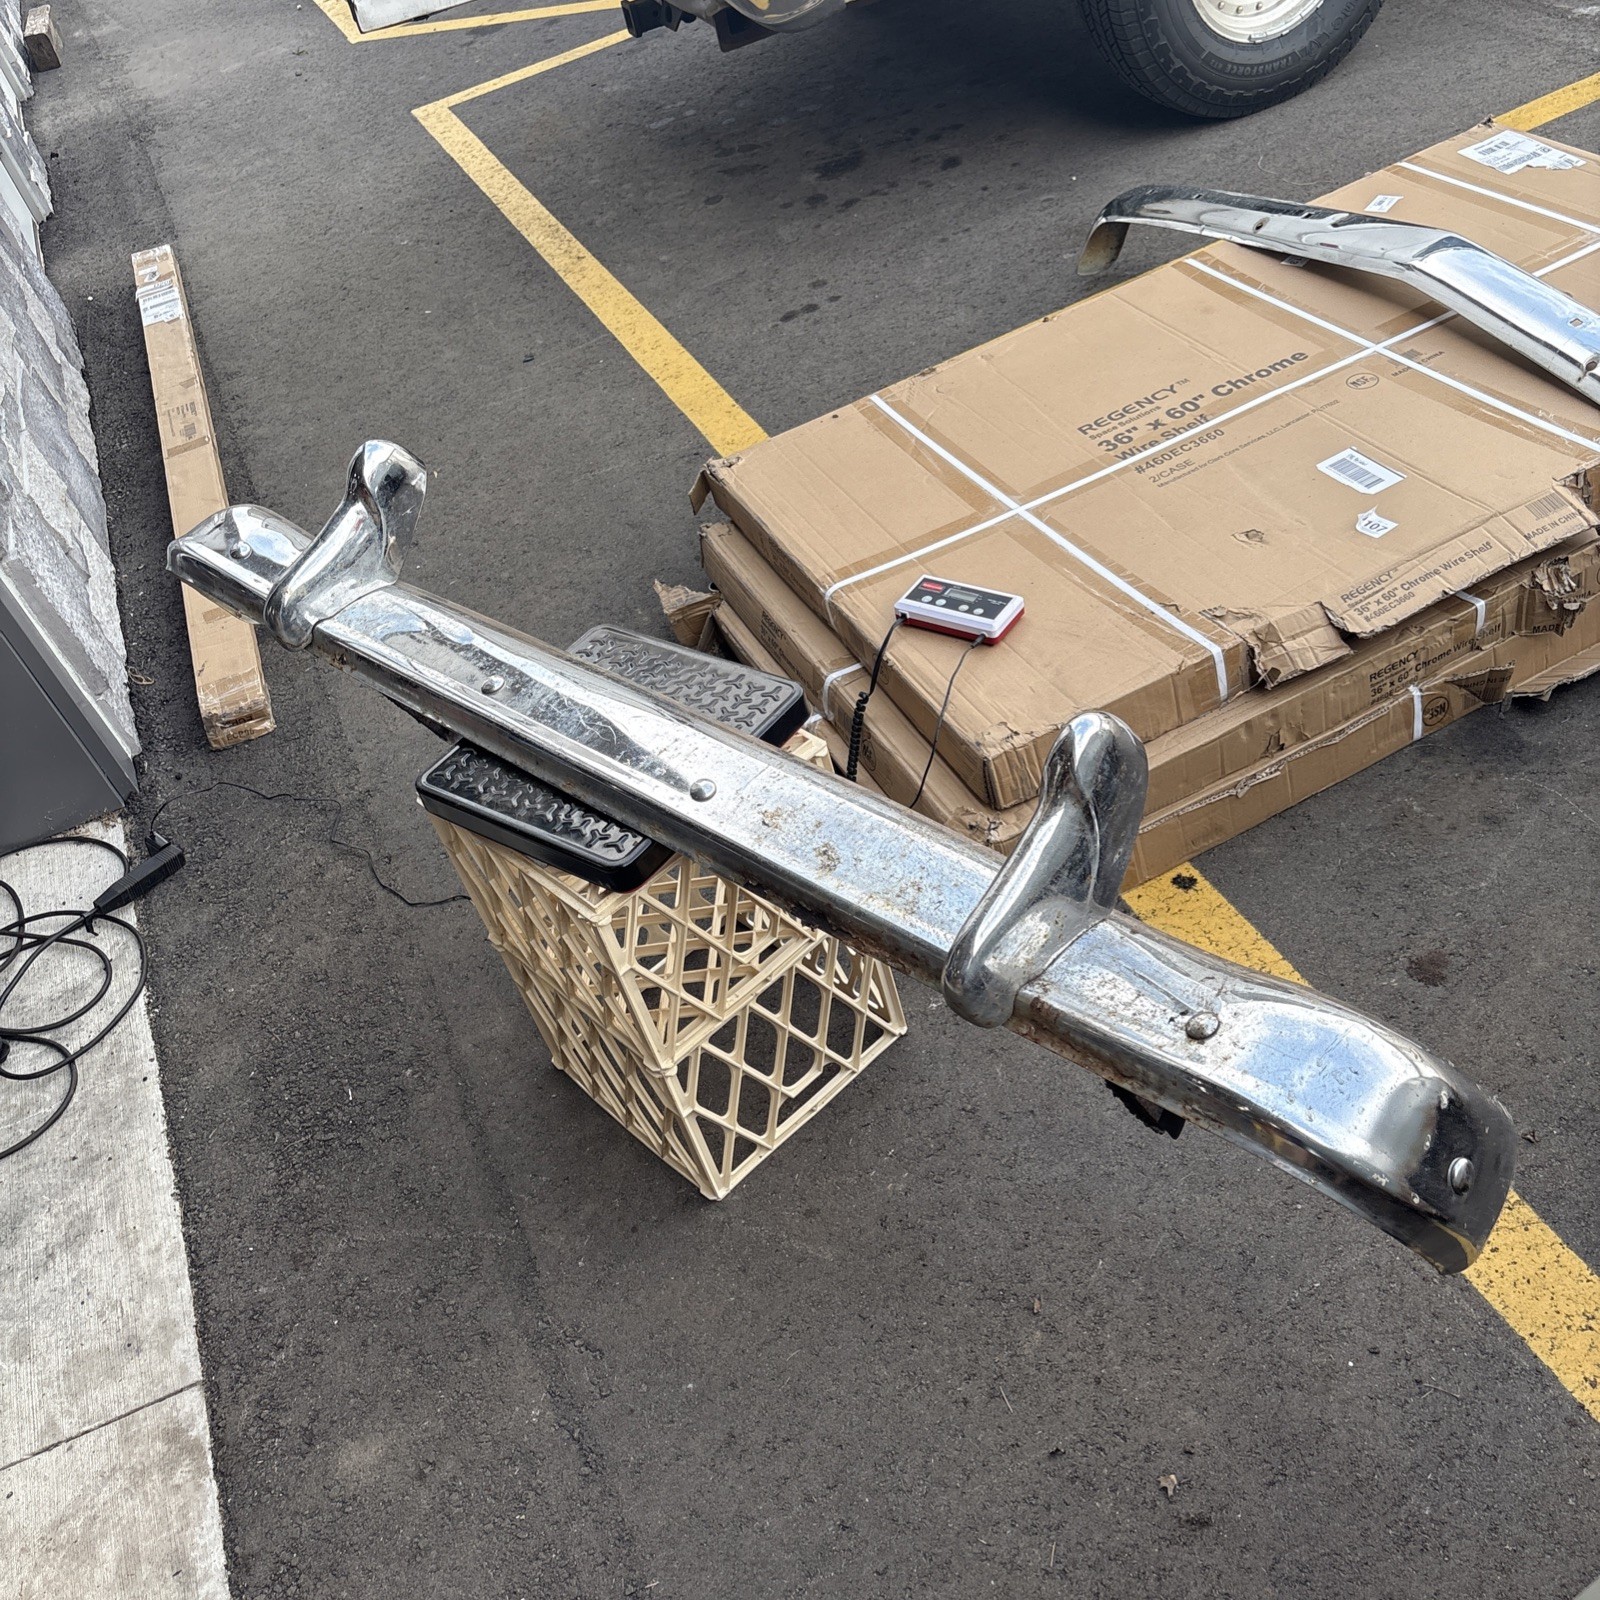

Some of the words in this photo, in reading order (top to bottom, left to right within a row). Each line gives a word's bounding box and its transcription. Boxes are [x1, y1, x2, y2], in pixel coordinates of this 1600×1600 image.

[1225, 56, 1293, 77] TRANSFORCE
[1097, 425, 1139, 452] 36"
[1146, 418, 1168, 431] x
[1165, 393, 1205, 419] 60"
[1211, 352, 1309, 397] Chrome
[1088, 425, 1118, 441] Space
[1117, 406, 1162, 427] Solutions
[1114, 439, 1160, 461] Wire
[1160, 413, 1210, 441] Shelf
[1134, 428, 1225, 475] #460EC3660
[1148, 458, 1196, 483] 2/CASE
[1523, 525, 1551, 541] MADE
[1548, 520, 1559, 529] IN
[1353, 601, 1372, 616] 36"
[1373, 598, 1383, 606] x
[1381, 587, 1398, 602] 60"
[1400, 568, 1442, 591] Chrome
[1439, 555, 1466, 571] Wire
[1464, 541, 1493, 559] Shelf
[1415, 650, 1452, 672] Chrome
